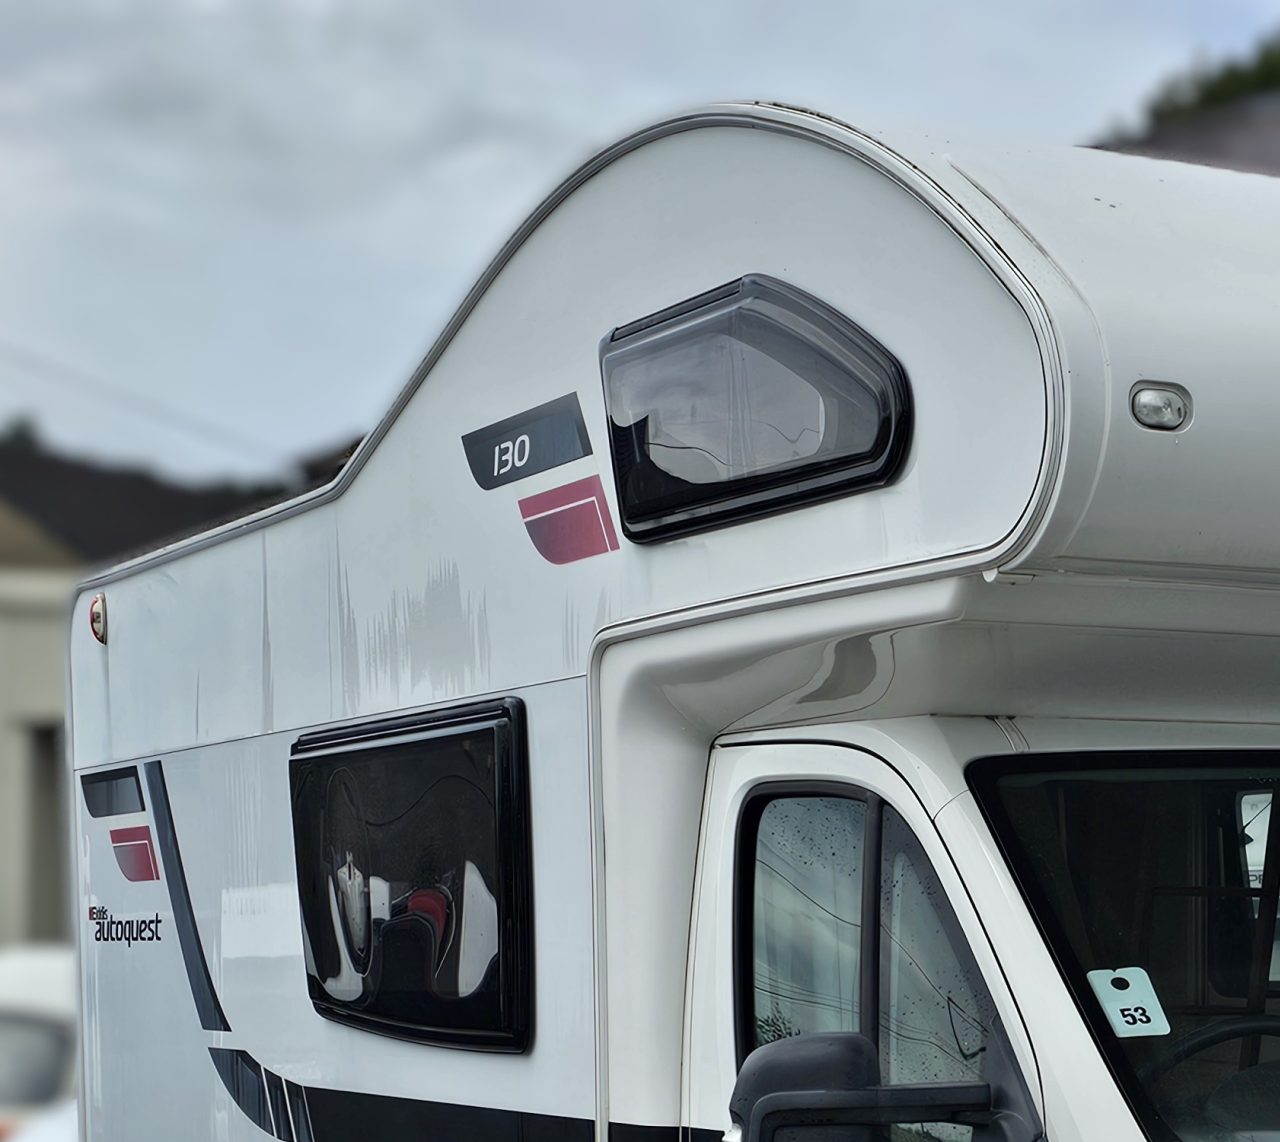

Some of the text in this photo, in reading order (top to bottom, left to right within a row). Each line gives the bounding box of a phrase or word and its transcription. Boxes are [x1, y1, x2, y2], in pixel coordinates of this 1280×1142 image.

[493, 434, 530, 476] 130
[95, 913, 162, 948] autoquest
[1119, 1006, 1152, 1026] 53
